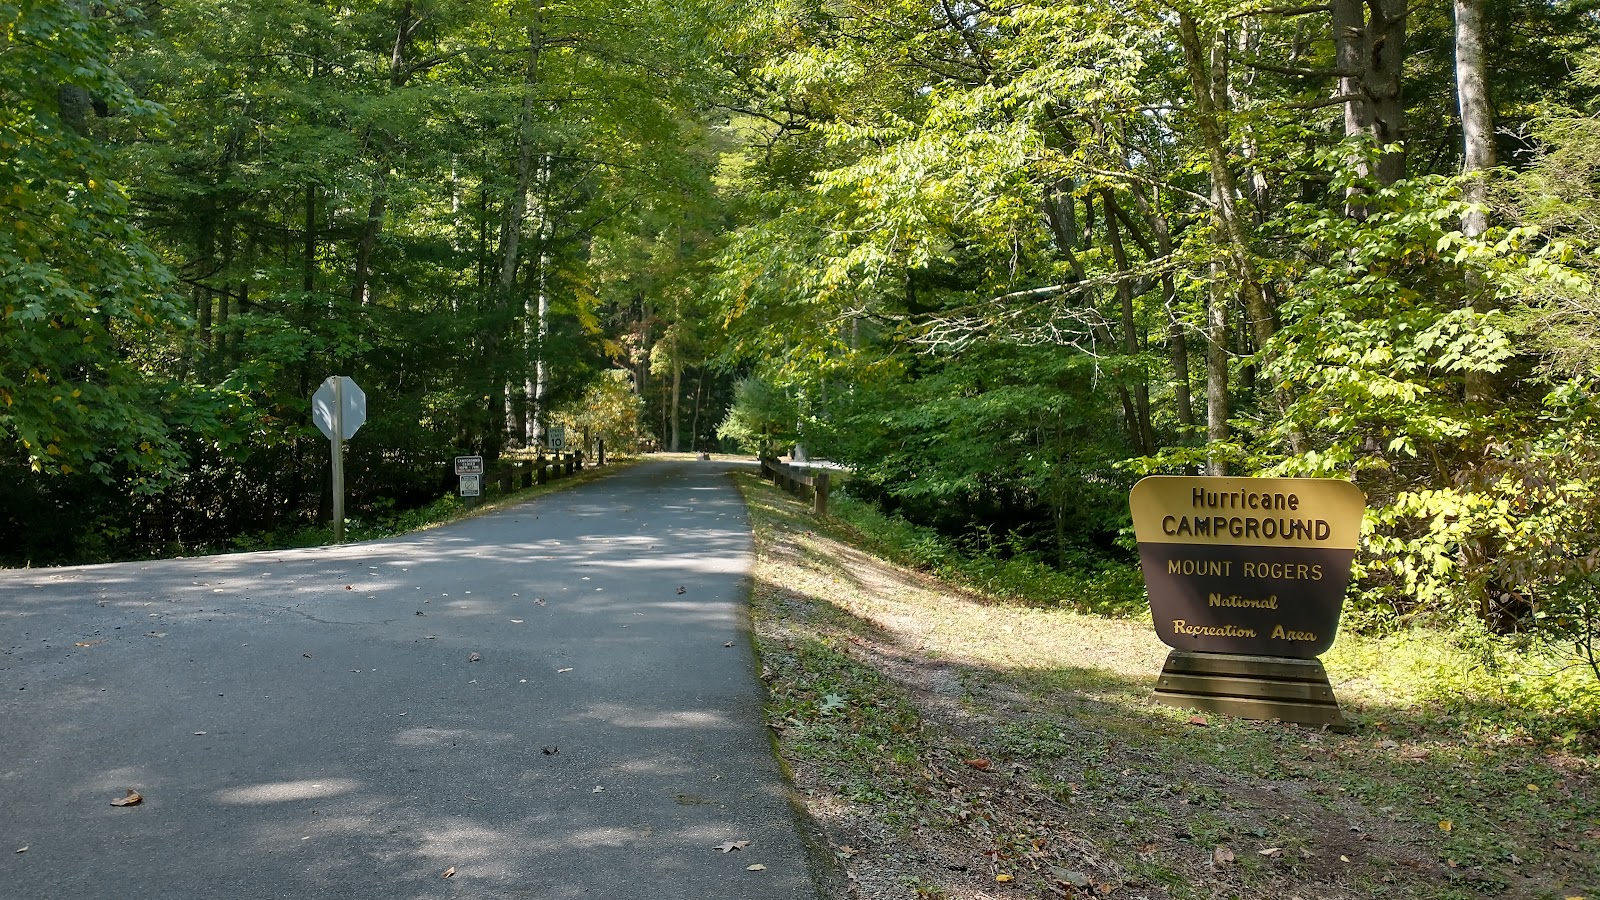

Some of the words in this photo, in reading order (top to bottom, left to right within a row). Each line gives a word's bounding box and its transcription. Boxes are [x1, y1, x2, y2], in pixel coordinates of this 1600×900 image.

[552, 438, 562, 446] 10
[1192, 488, 1299, 511] Hurricane
[1162, 515, 1330, 541] CAMPGROUND
[1168, 559, 1232, 576] MOUNT
[1244, 562, 1323, 581] ROGERS
[1208, 592, 1278, 610] National
[1172, 619, 1257, 638] Recreation
[1271, 624, 1318, 642] Area
